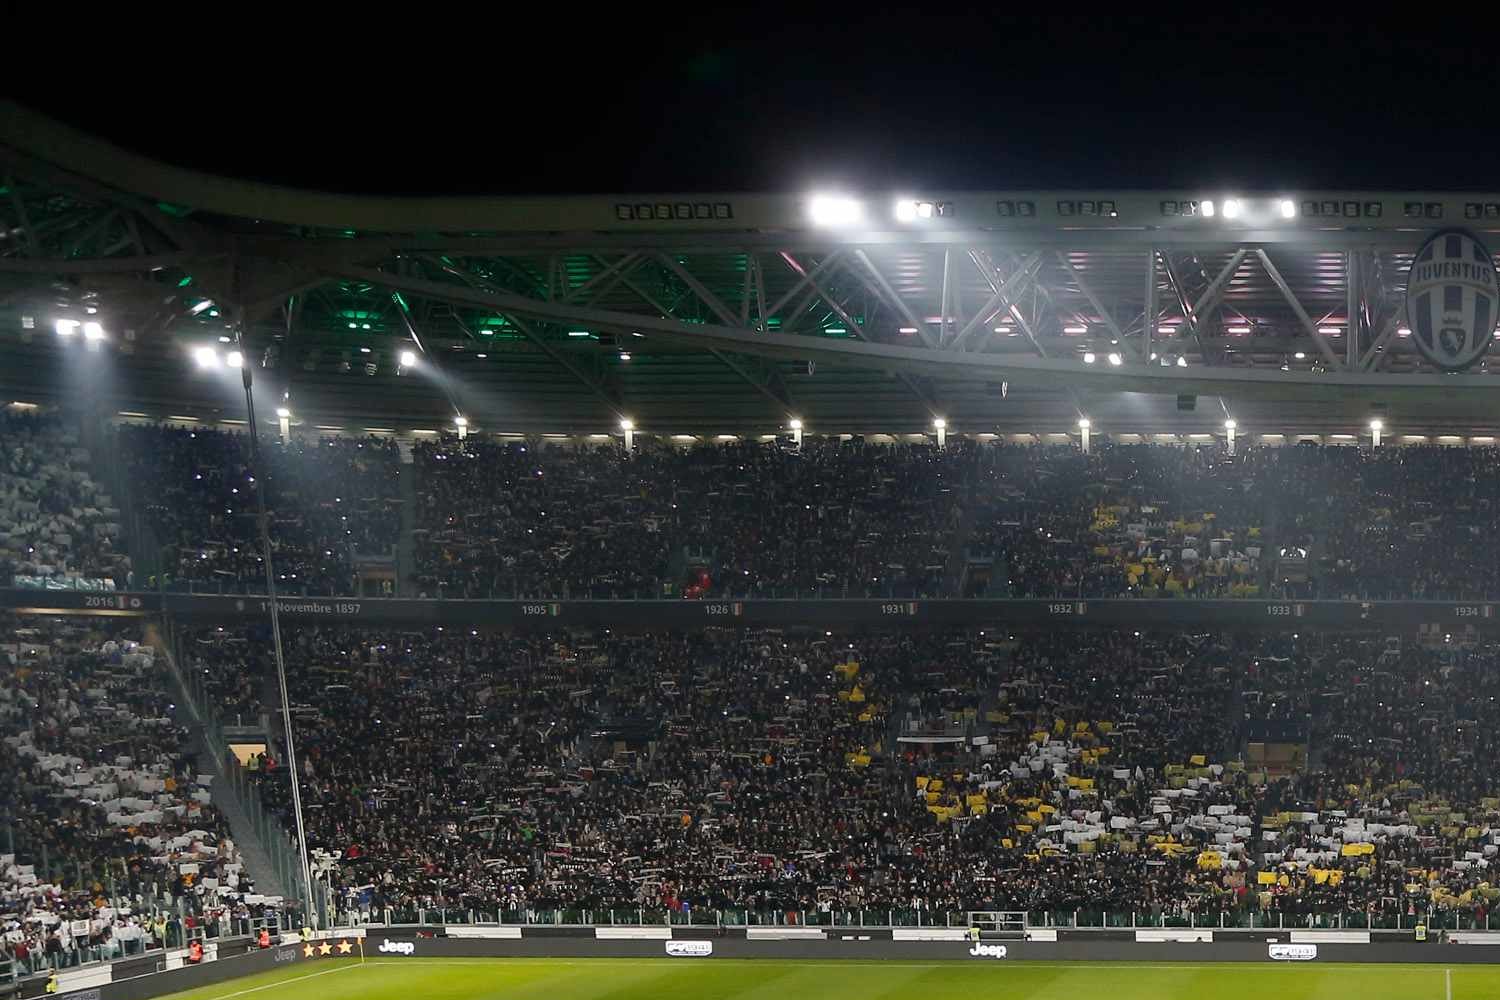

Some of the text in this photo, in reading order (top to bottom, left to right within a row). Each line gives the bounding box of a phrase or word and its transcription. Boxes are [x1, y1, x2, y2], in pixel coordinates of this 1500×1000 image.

[1416, 261, 1491, 283] JUVENTUS
[85, 597, 114, 608] 2016
[336, 603, 361, 614] 1897
[521, 605, 546, 615] 1905
[705, 605, 728, 614] 1926
[882, 604, 904, 614] 1931
[1048, 604, 1072, 614] 1932
[1267, 605, 1290, 615] 1933
[1455, 606, 1477, 616] 1934
[378, 938, 415, 956] Jeep
[969, 941, 1008, 959] Jeep
